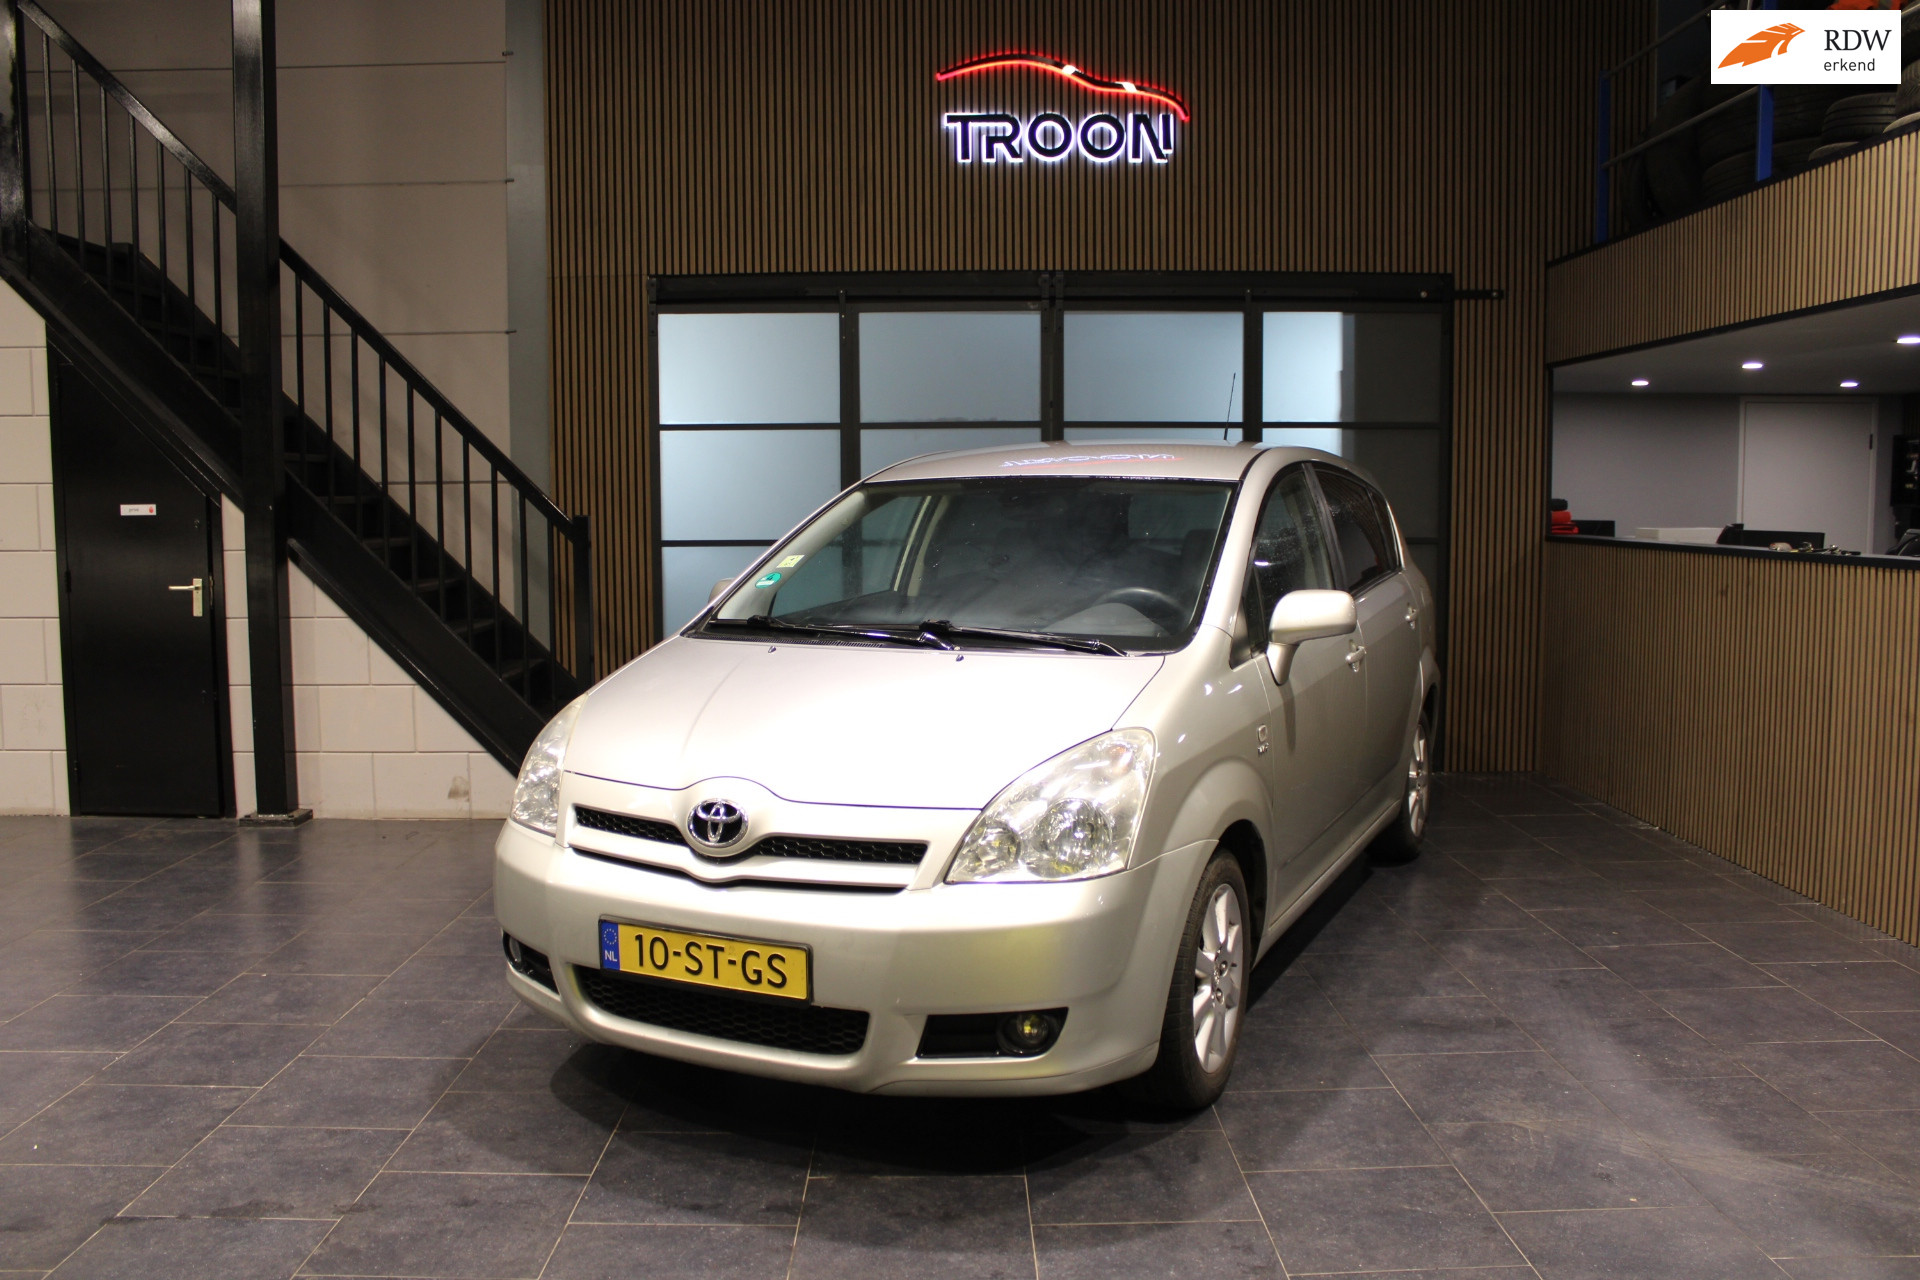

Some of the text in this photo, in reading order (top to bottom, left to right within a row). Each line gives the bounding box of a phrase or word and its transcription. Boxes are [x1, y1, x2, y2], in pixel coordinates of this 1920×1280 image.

[945, 113, 1173, 162] TROON
[604, 950, 618, 962] NL
[634, 934, 787, 988] 10-ST-GS
